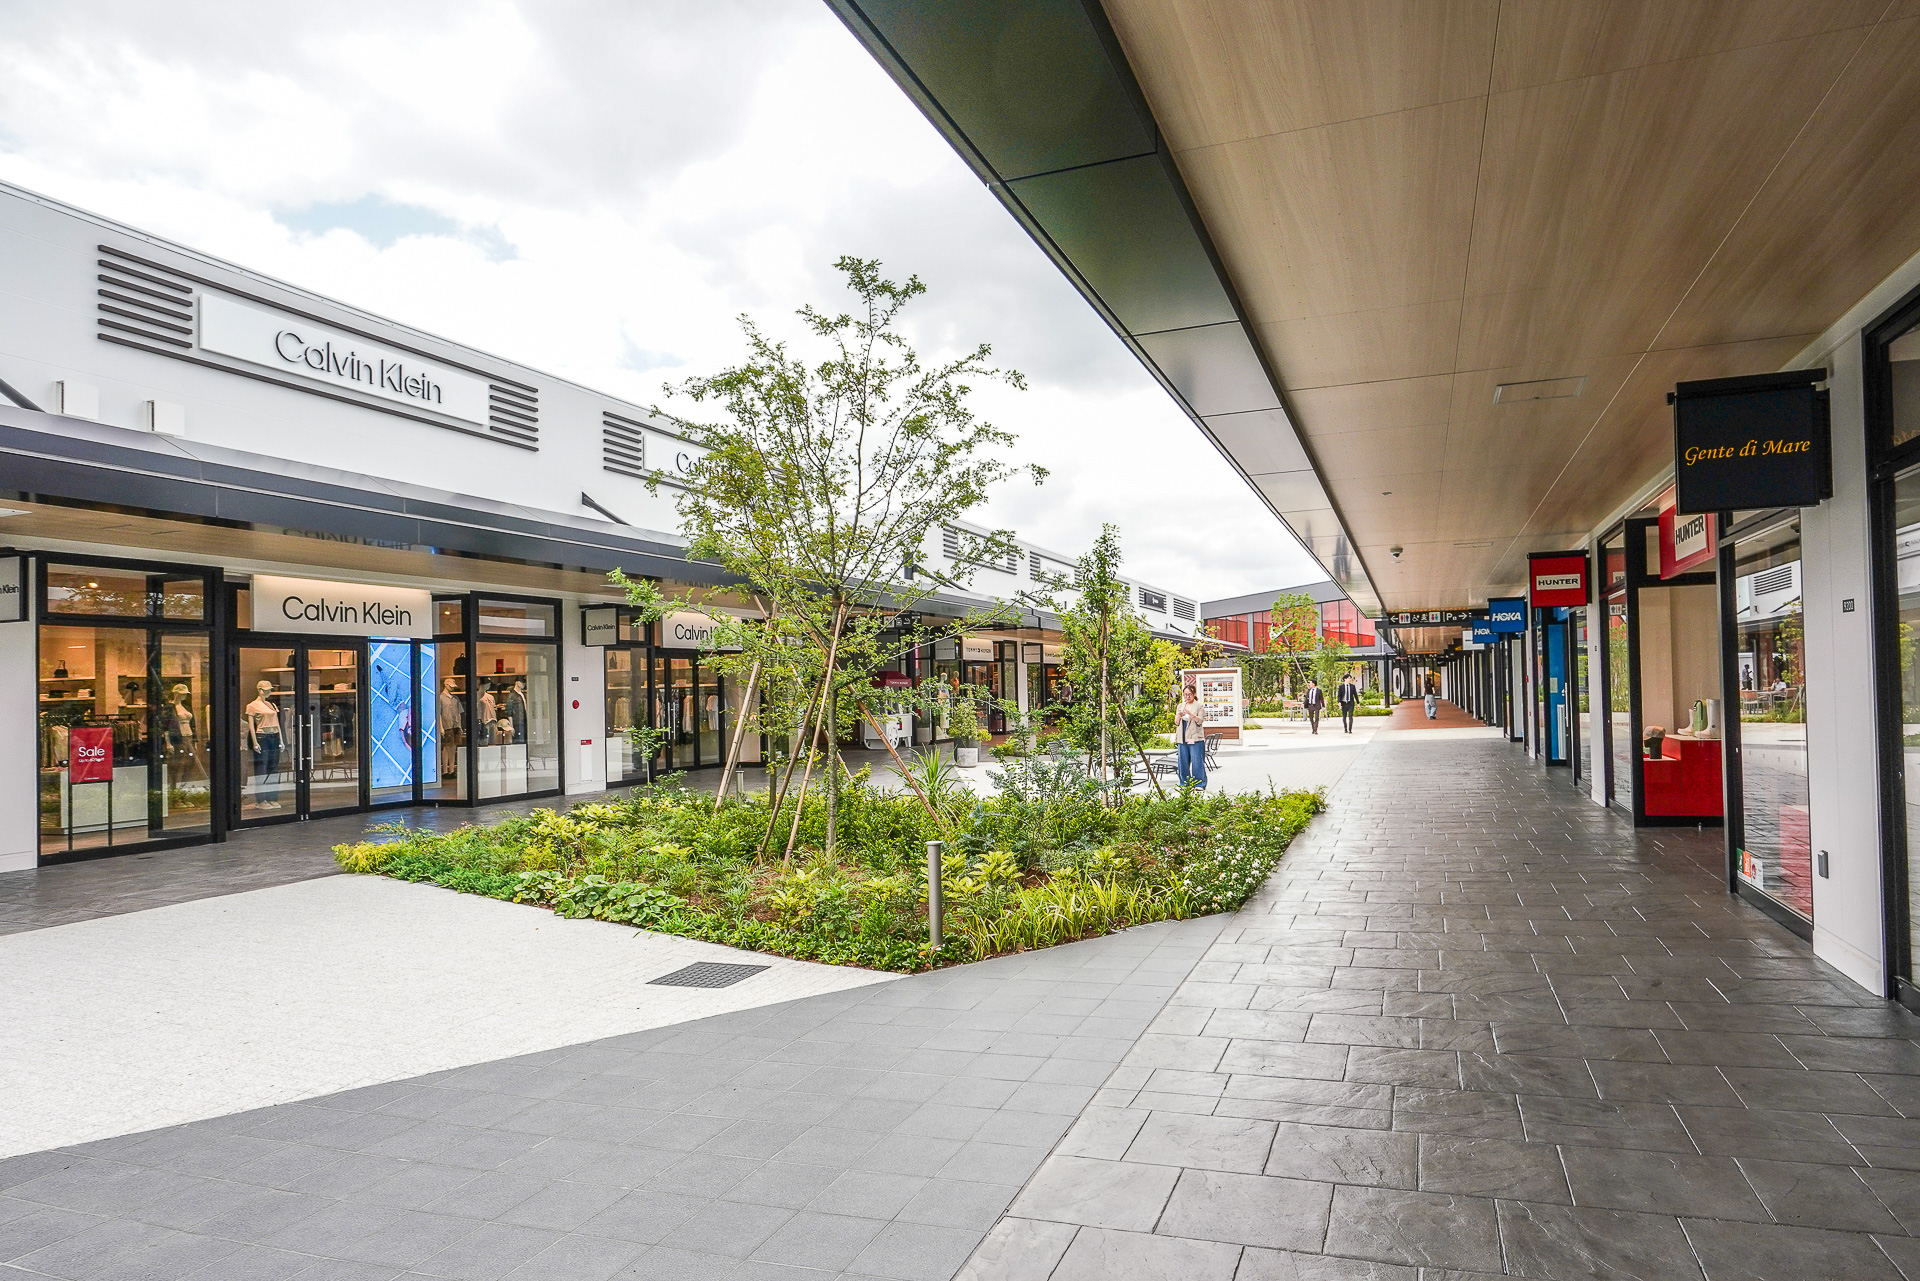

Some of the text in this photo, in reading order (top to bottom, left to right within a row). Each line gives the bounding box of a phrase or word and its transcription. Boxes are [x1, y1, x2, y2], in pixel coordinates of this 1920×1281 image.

[276, 330, 442, 404] Calvin Klein
[1685, 439, 1811, 466] Gente di Mare
[1675, 514, 1705, 546] HUNTER
[2, 584, 20, 594] Klein
[1538, 578, 1579, 586] HUNTER
[282, 595, 412, 626] Calvin Klein
[1492, 612, 1522, 622] HOKA
[675, 623, 709, 640] Calvin
[1474, 628, 1497, 636] HOK
[78, 746, 105, 757] Sale
